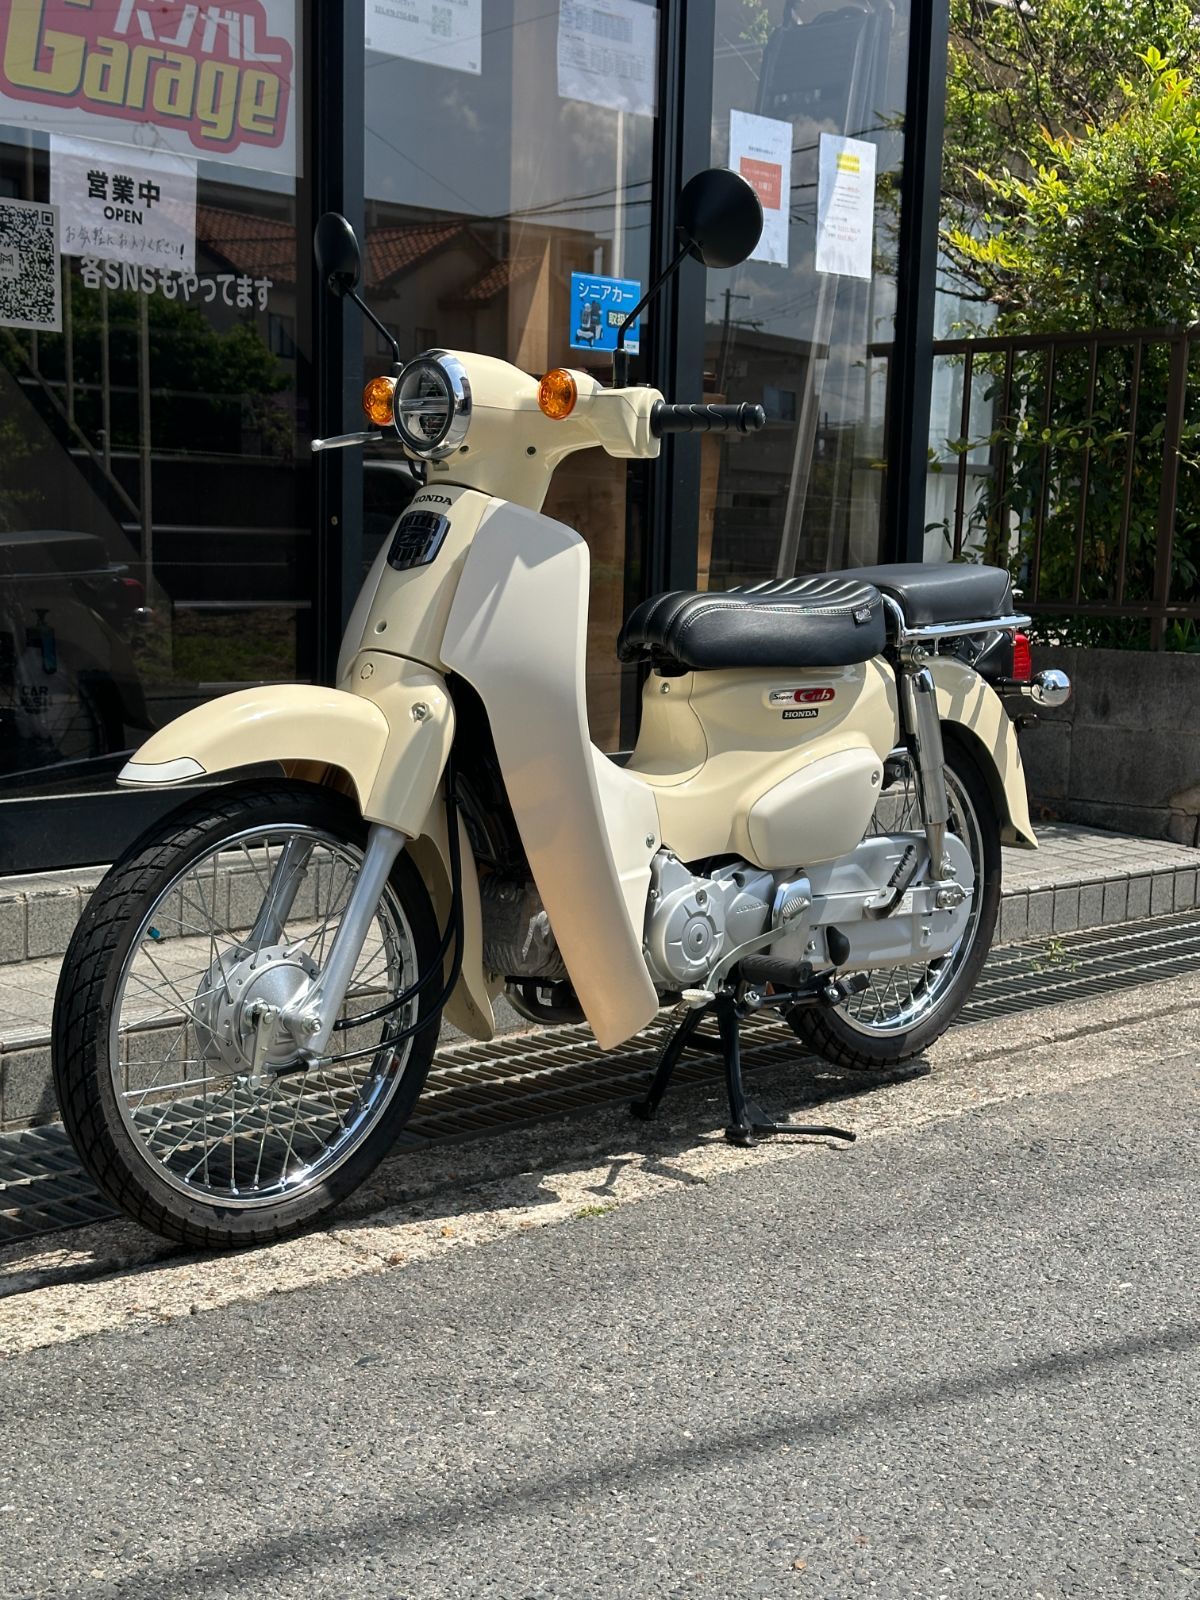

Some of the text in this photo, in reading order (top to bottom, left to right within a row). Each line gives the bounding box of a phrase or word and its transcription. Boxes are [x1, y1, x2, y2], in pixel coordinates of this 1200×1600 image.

[3, 0, 281, 140] Garage
[87, 169, 161, 208] 営業中
[103, 205, 143, 225] OPEN
[80, 252, 273, 311] 各SNSもやってます
[578, 282, 633, 302] シニアカー
[608, 312, 634, 328] 取扱
[413, 494, 452, 506] HONDA
[773, 689, 830, 702] Super Cub
[784, 709, 818, 718] HONDA
